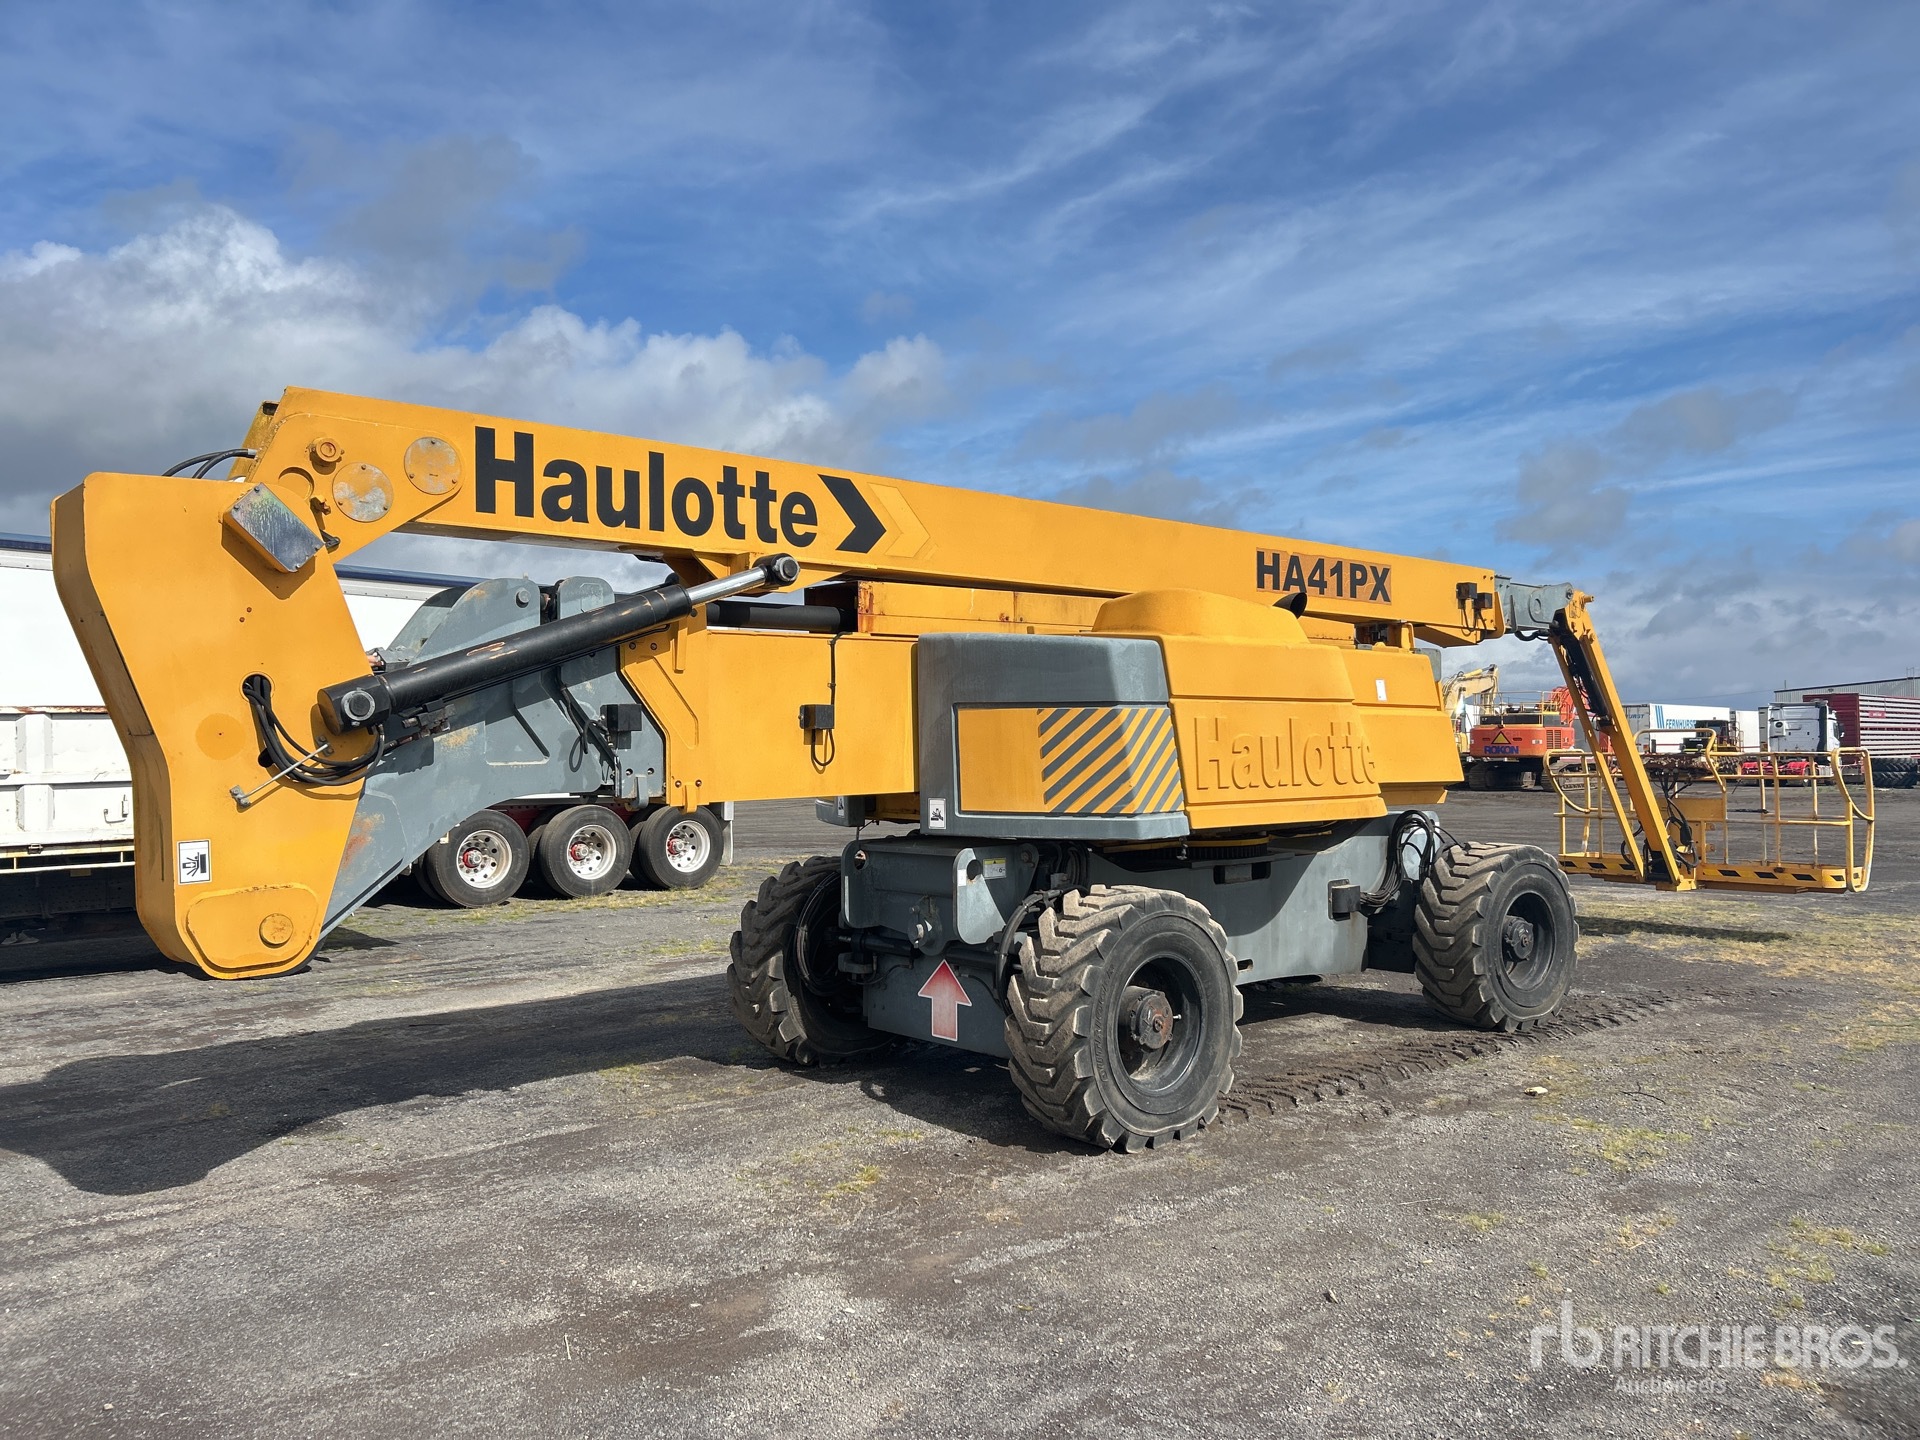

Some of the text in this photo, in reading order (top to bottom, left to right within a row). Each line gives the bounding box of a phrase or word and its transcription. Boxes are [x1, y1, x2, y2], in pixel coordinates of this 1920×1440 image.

[475, 426, 818, 547] Haulotte
[1256, 550, 1391, 603] HA41PX
[1194, 716, 1376, 790] Haulotte
[1484, 745, 1519, 754] ROKON
